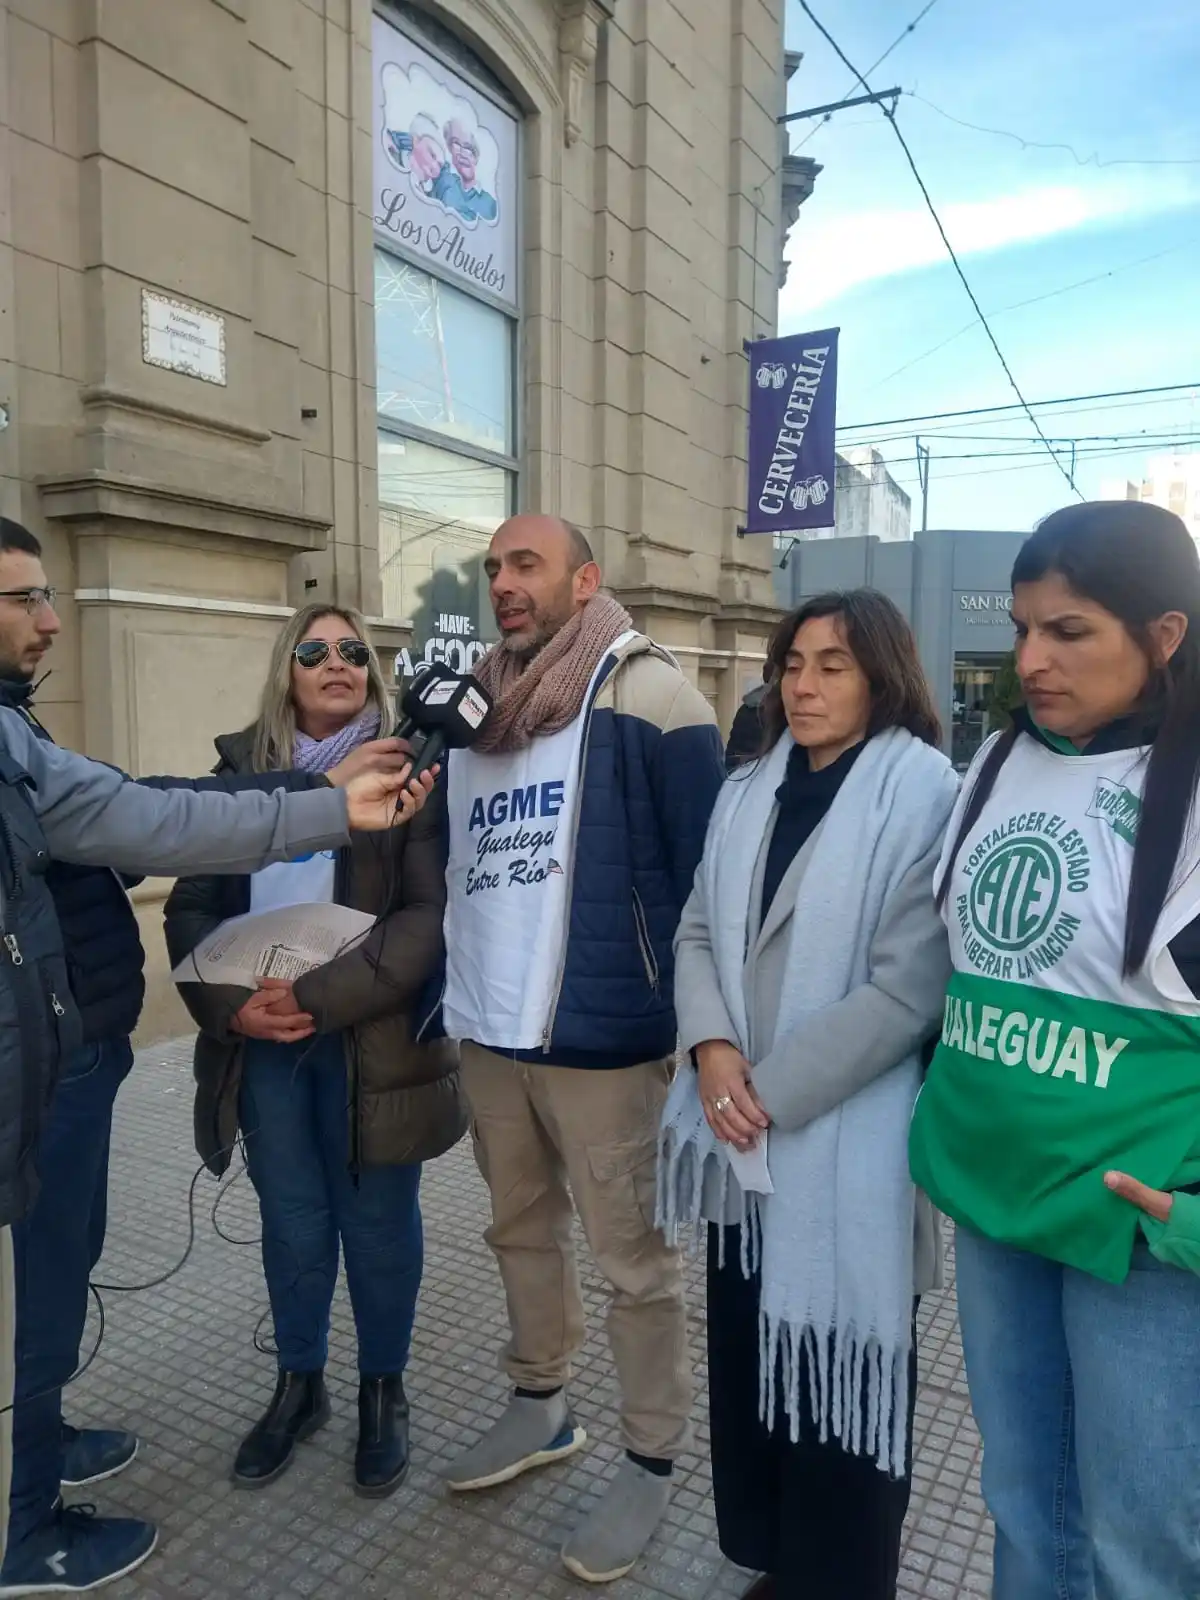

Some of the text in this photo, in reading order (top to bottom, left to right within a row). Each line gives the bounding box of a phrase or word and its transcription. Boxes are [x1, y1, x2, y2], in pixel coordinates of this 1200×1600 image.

[374, 188, 506, 292] Los Abuelos
[758, 346, 830, 514] CERVECERÍA
[960, 595, 990, 611] SAN
[394, 637, 497, 676] A GOO
[468, 780, 565, 832] AGME
[466, 866, 500, 896] Entre
[962, 811, 1090, 893] FORTALECER EL ESTADO
[977, 848, 1051, 940] ATE
[957, 894, 1082, 979] PARA LIBERAR LA NACION
